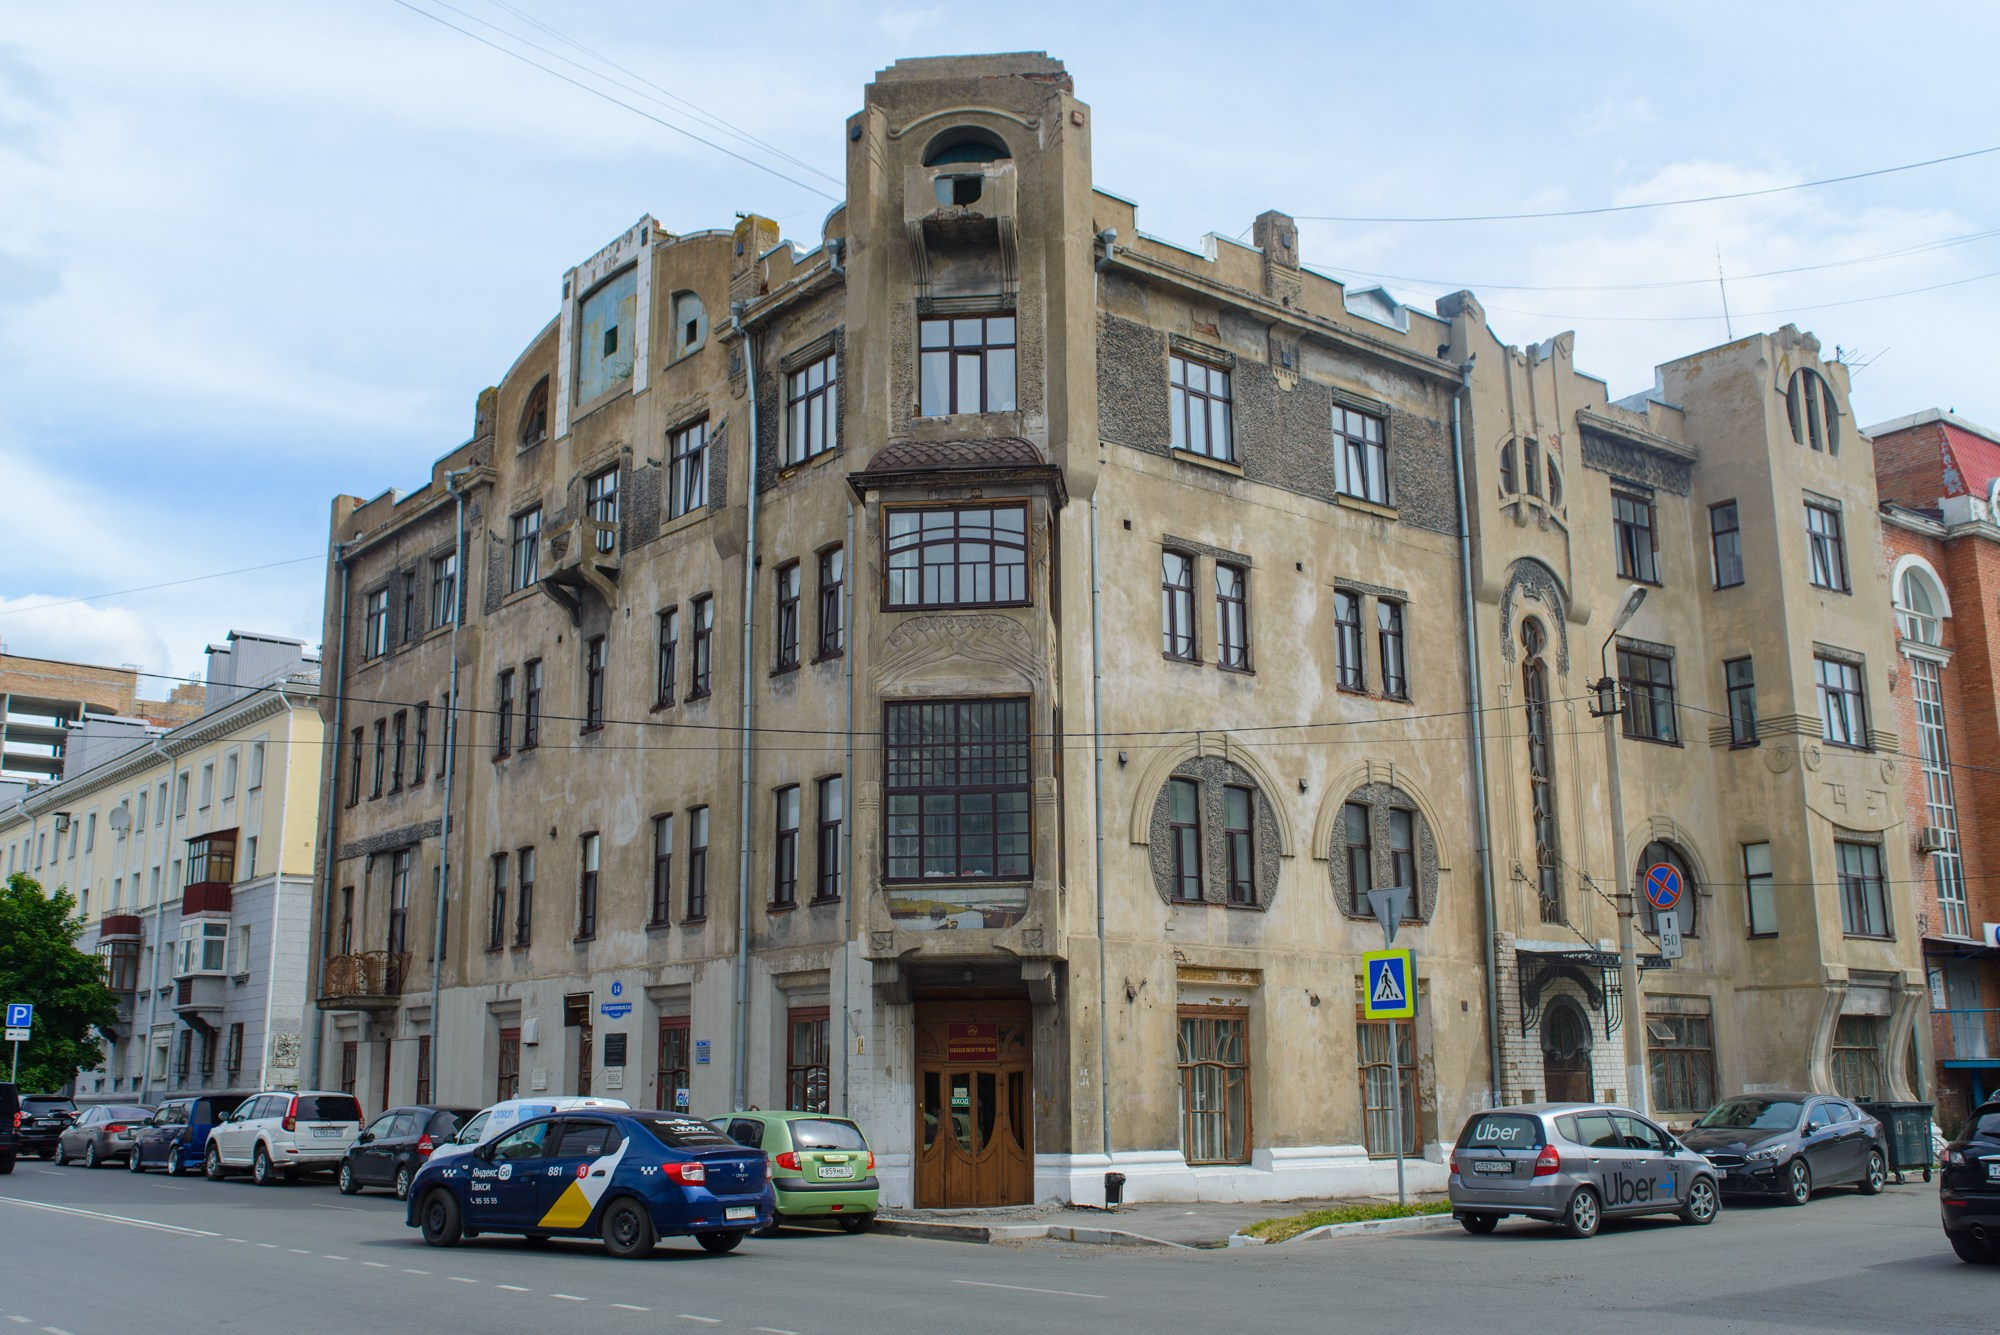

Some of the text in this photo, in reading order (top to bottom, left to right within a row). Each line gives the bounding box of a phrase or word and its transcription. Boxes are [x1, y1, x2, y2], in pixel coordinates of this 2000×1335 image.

[1663, 934, 1677, 946] 50
[613, 985, 621, 994] 14
[12, 1006, 27, 1024] P
[951, 1098, 969, 1106] ВХОД
[1476, 1123, 1521, 1141] Uber
[547, 1166, 563, 1176] 881
[1621, 1162, 1632, 1170] 592
[1668, 1163, 1680, 1171] Uber
[472, 1167, 510, 1178] Яндекс Go
[471, 1181, 491, 1191] Такси
[1602, 1172, 1656, 1206] Uber
